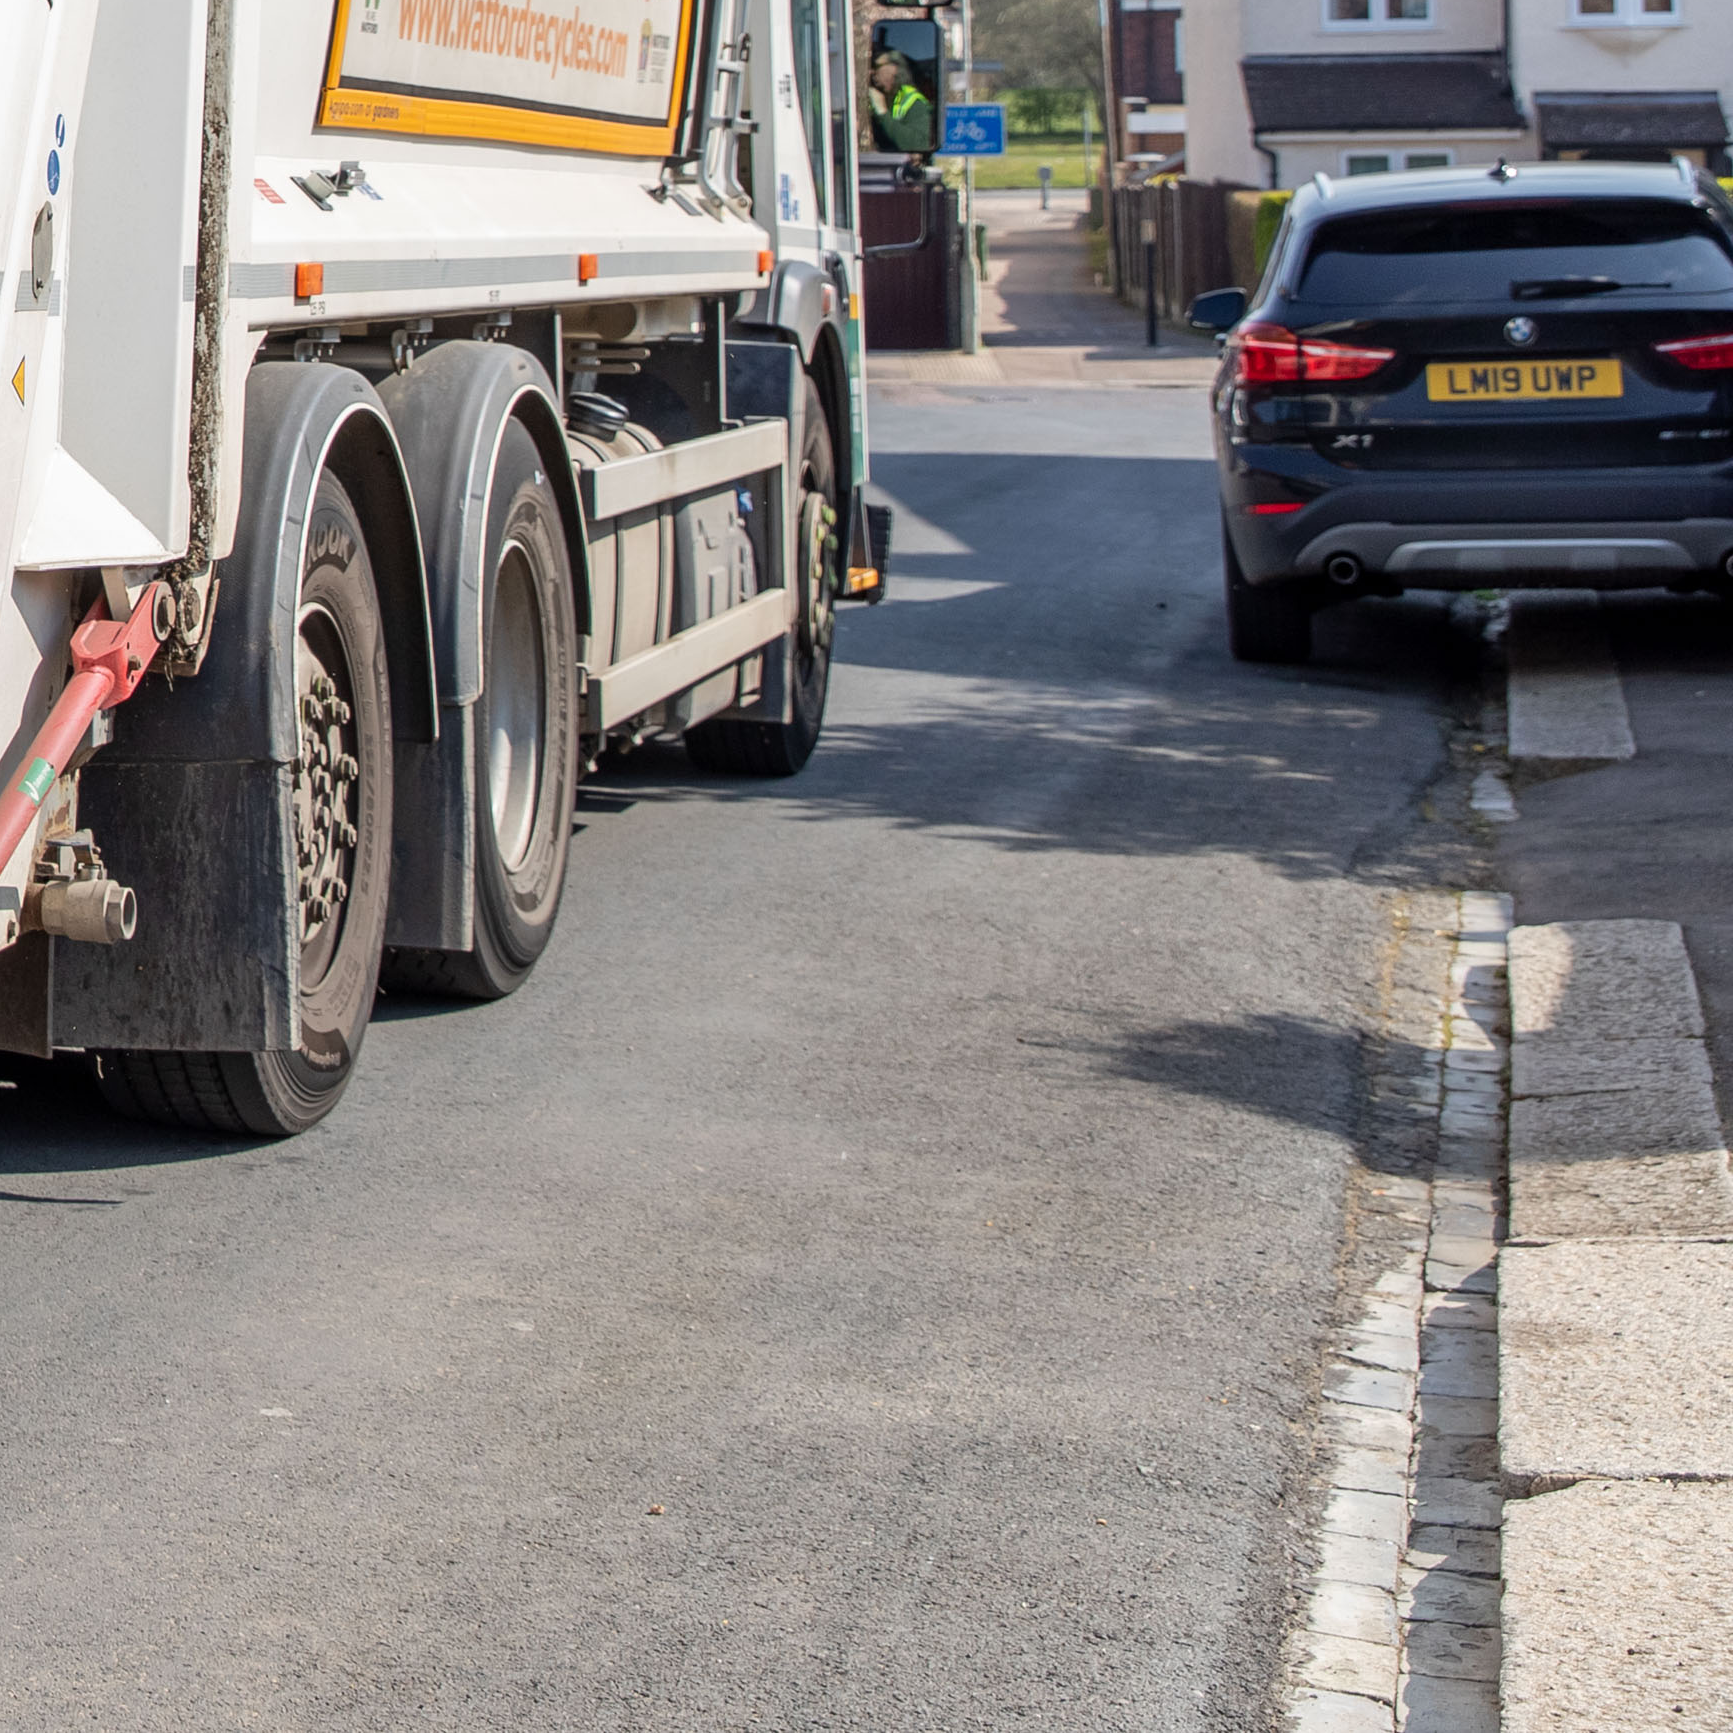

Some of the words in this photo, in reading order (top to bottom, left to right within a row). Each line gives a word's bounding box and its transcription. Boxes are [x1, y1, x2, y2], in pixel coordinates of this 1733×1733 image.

[1447, 367, 1523, 395] LM19
[1533, 366, 1597, 393] UWP
[1332, 434, 1374, 449] X1
